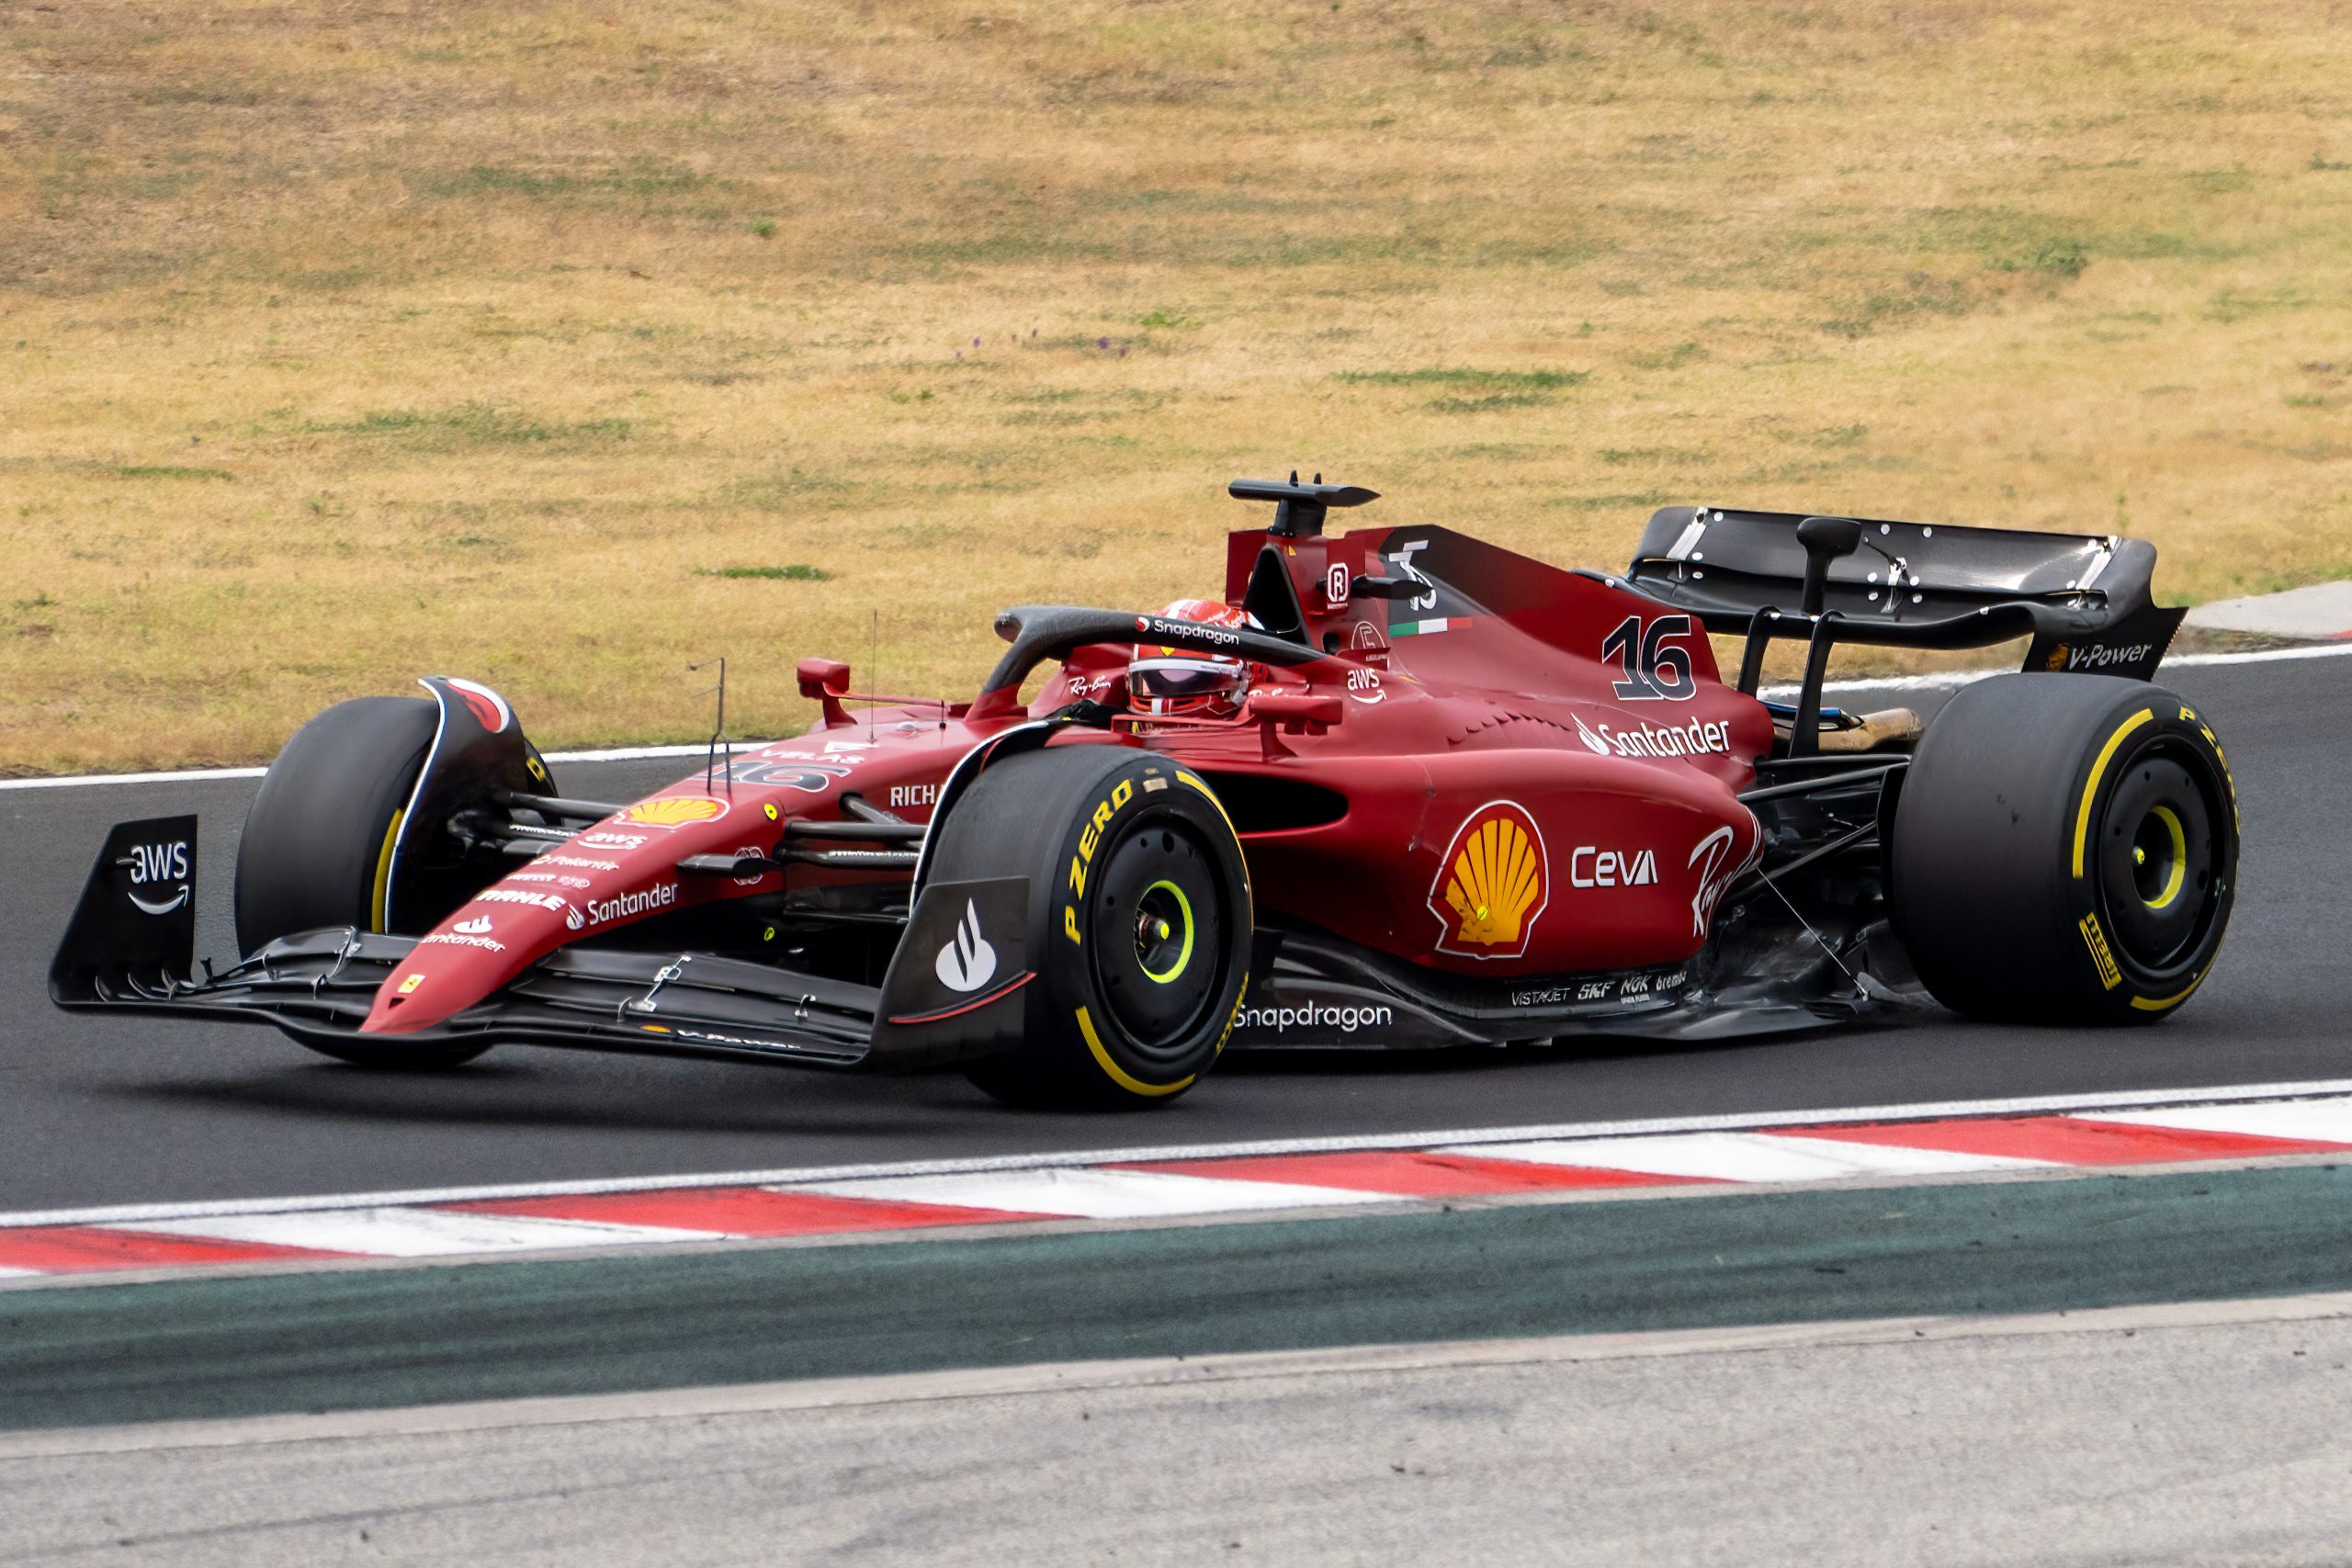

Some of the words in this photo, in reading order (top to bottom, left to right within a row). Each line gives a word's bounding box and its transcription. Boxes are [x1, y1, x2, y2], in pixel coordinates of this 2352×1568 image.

[1154, 619, 1239, 646] Snapdragon
[1602, 615, 1697, 702] 16
[2069, 643, 2153, 671] V-Power
[1347, 668, 1381, 691] aws
[1602, 716, 1731, 758] Santander
[889, 784, 946, 807] RICH
[1069, 779, 1133, 900] ZERO
[130, 840, 187, 884] aws
[477, 889, 567, 912] MAHLE
[588, 883, 678, 926] Santander
[1065, 905, 1081, 946] P
[421, 933, 506, 953] antander
[1577, 981, 1616, 1000] SKF
[1621, 975, 1653, 996] NGK
[1233, 998, 1392, 1033] Snapdragon
